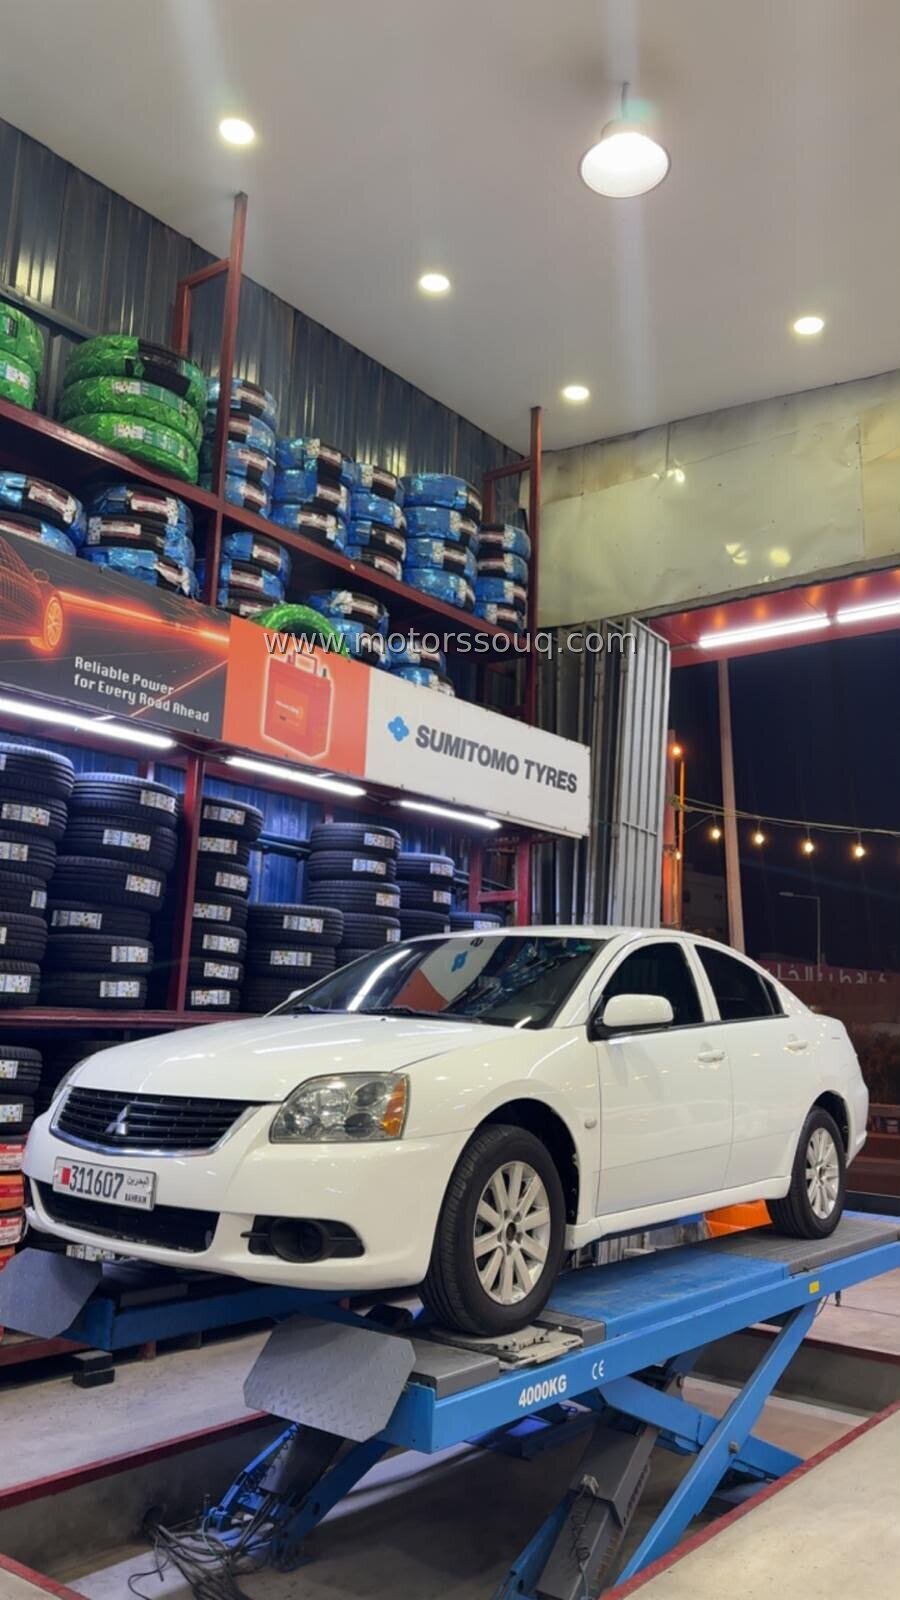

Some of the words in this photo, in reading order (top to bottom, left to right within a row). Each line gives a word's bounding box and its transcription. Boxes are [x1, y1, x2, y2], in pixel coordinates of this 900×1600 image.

[75, 656, 130, 683] Reliable
[132, 673, 175, 696] Power
[74, 674, 96, 690] for
[98, 680, 136, 705] Every
[139, 692, 170, 712] Road
[172, 702, 210, 723] Ahead
[415, 725, 519, 775] SUMITOMO
[524, 759, 578, 793] TYRES
[69, 1165, 124, 1199] 311607
[518, 1374, 567, 1407] 4000KG
